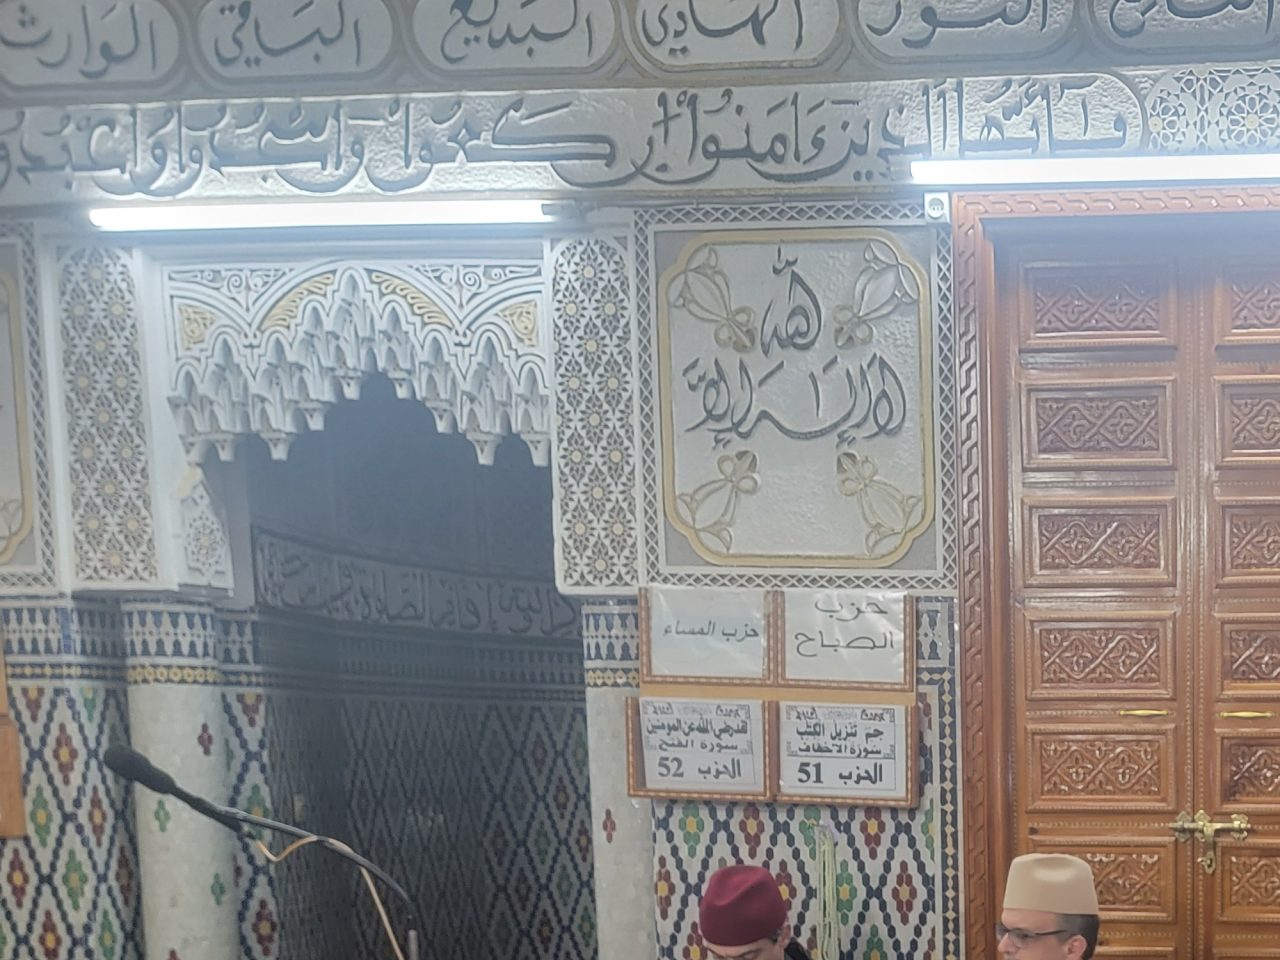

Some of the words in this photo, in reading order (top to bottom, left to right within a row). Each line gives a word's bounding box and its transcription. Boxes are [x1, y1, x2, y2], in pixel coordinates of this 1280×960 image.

[814, 599, 889, 623] حزب
[662, 619, 716, 637] المساء
[721, 622, 760, 643] حزب
[794, 629, 894, 658] الصباح
[658, 737, 694, 752] الفتح
[657, 756, 685, 778] 52
[697, 757, 742, 780] الحزب
[797, 761, 824, 784] 51
[838, 761, 883, 785] الحزب
